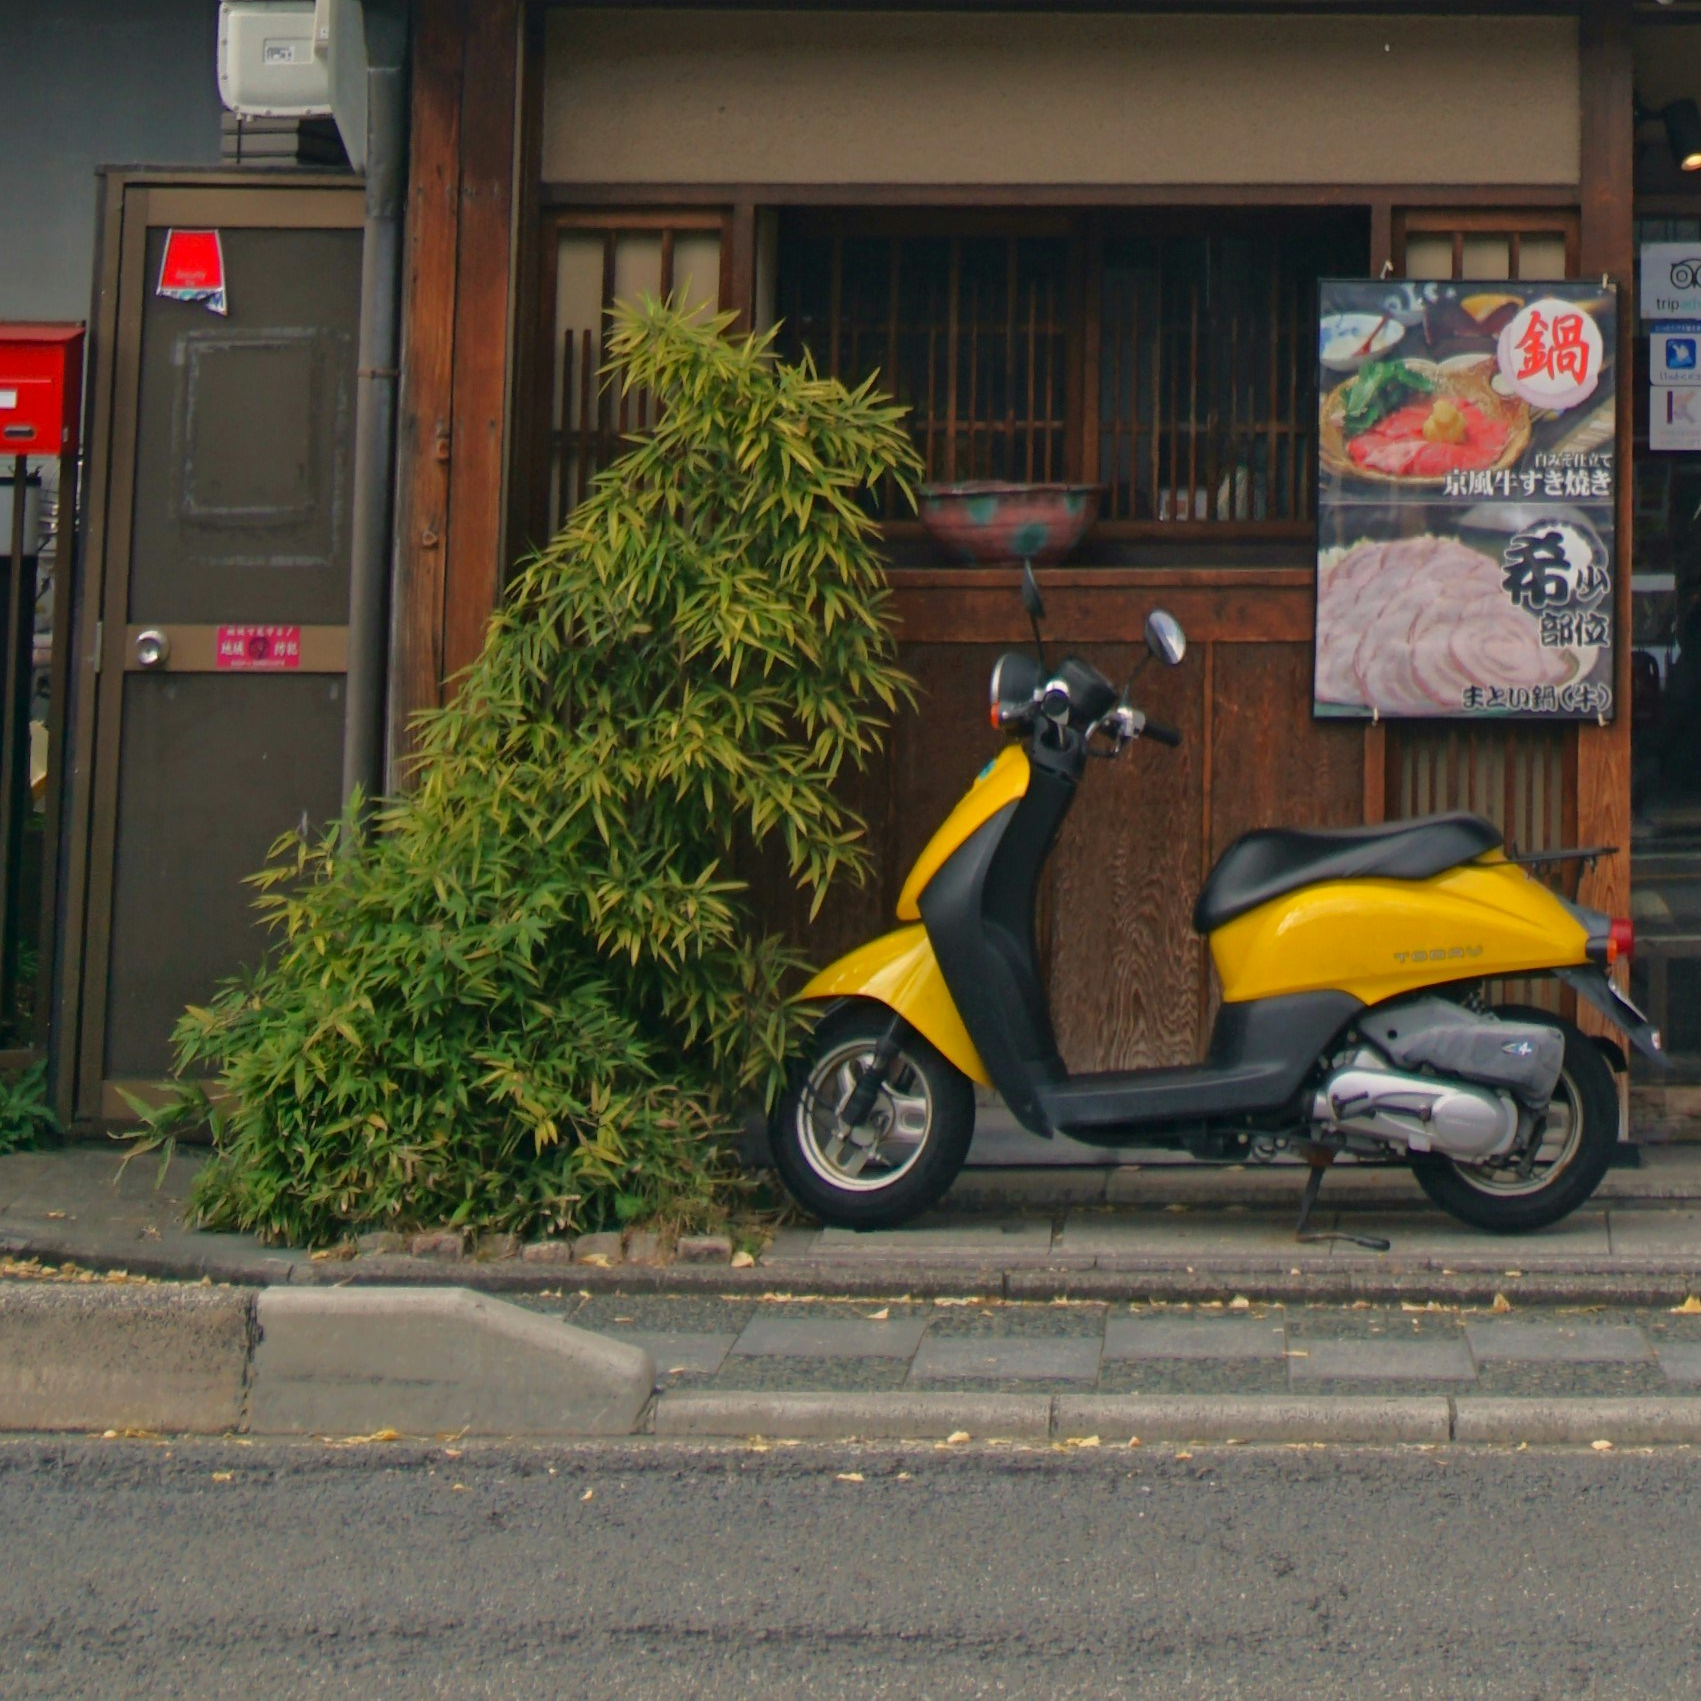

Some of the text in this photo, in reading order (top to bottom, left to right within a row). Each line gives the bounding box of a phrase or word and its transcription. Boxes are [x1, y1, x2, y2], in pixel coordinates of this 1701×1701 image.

[1514, 310, 1591, 387] 鍋
[1535, 452, 1613, 468] 白みそ仕立て
[1442, 468, 1612, 497] 京風牛すき焼き
[1539, 612, 1610, 648] 部位
[1393, 944, 1484, 964] TODAY
